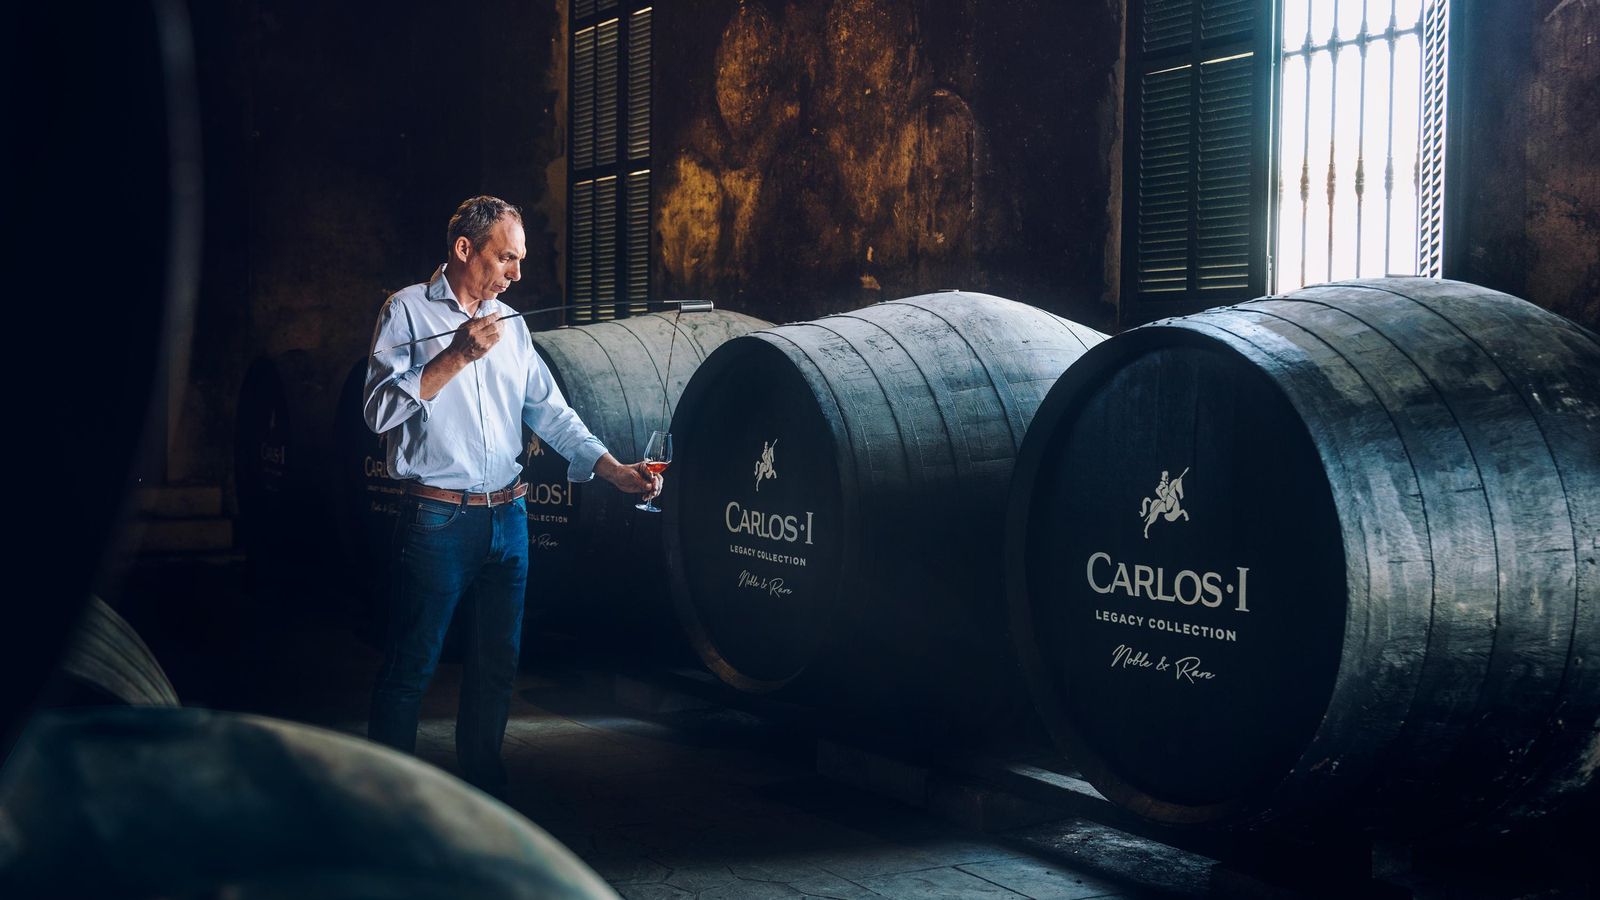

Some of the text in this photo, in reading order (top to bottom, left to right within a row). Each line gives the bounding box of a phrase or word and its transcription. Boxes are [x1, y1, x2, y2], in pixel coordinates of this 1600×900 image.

[725, 501, 814, 545] CARLOS·I
[730, 544, 807, 567] LEGACY COLLECTION
[738, 569, 793, 598] Noble & Rare
[1087, 551, 1250, 612] CARLOS·I
[1095, 609, 1237, 641] LEGACY COLLECTION
[1110, 644, 1216, 684] Noble & Rare
